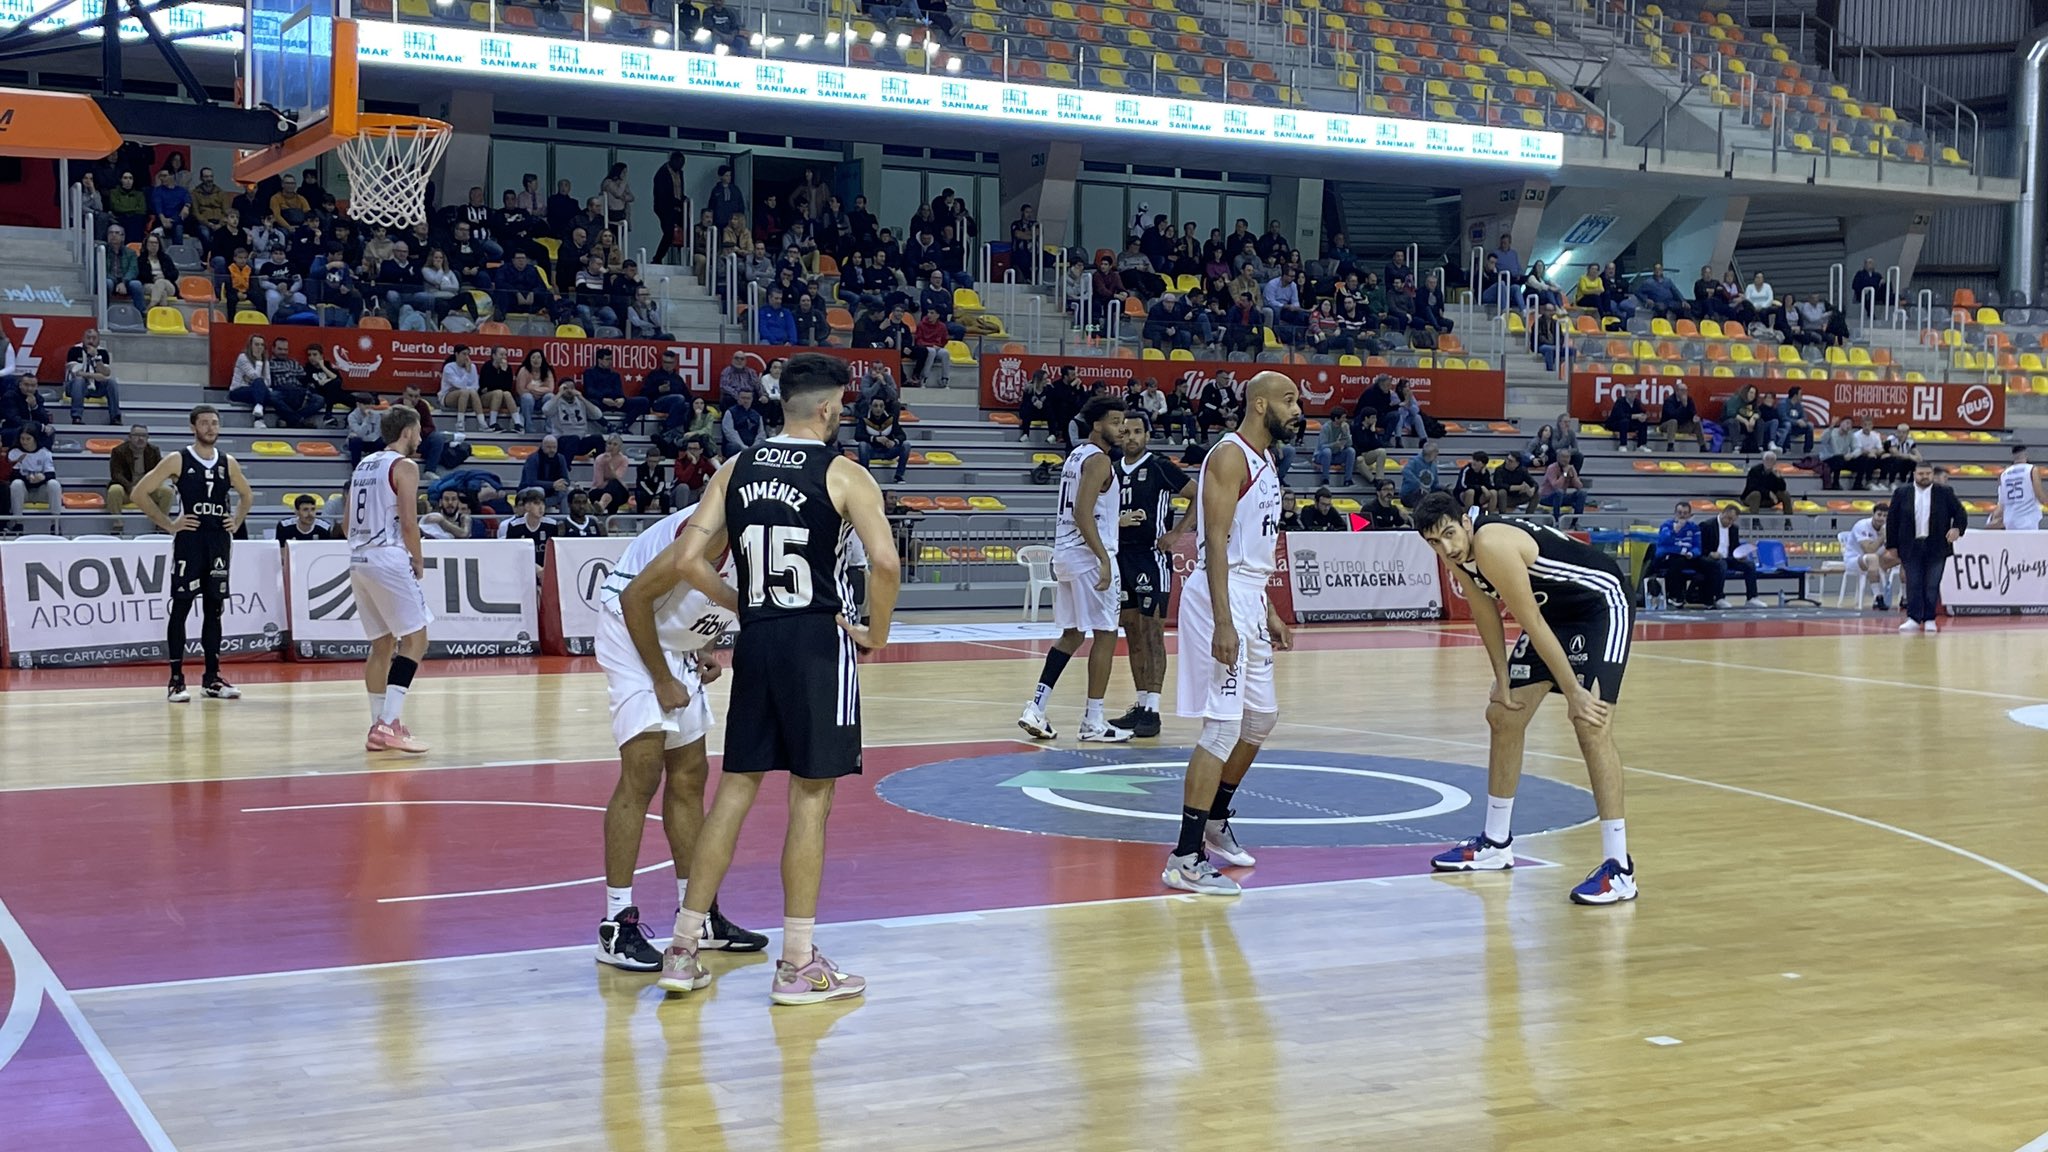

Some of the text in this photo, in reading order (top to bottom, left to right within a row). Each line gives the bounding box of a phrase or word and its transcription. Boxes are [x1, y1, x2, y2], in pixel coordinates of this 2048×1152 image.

[403, 51, 462, 63] SANIMAR
[480, 57, 537, 69] SANIMAR
[549, 64, 604, 76] SANIMAR
[621, 70, 675, 82] SANIMAR
[688, 77, 740, 89] SANIMAR
[757, 83, 806, 95] SANIMAR
[817, 89, 866, 100] SANIMAR
[881, 95, 930, 106] SANIMAR
[941, 100, 988, 111] SANIMAR
[1002, 106, 1048, 117] SANIMAR
[1057, 111, 1102, 121] SANIMAR
[1115, 116, 1158, 126] SANIMAR
[1169, 121, 1211, 131] SANIMAR
[1223, 126, 1265, 136] SANIMAR
[1273, 131, 1314, 140] SANIMAR
[1326, 135, 1367, 144] SANIMAR
[1376, 140, 1414, 149] SANIMAR
[1426, 144, 1464, 152] SANIMAR
[1472, 148, 1508, 156] SANIMAR
[392, 341, 434, 354] Puerto
[438, 344, 454, 355] de
[574, 344, 657, 369] HANEROS
[1041, 362, 1133, 378] Ayutamiento
[1341, 374, 1371, 385] Puerto
[1595, 376, 1682, 404] Fotin
[1834, 384, 1908, 405] LOS HABANEROS
[1853, 408, 1885, 418] HOTEL
[755, 447, 807, 465] ODILO
[206, 481, 214, 498] 7
[738, 478, 807, 512] JIMÉNEZ
[1120, 486, 1133, 505] 11
[2006, 481, 2024, 500] 25
[356, 488, 367, 525] 8
[178, 560, 187, 577] 7
[739, 524, 813, 608] 15
[1324, 558, 1405, 574] FÚTBOL CLUB
[1954, 554, 1992, 590] FCC
[1998, 548, 2047, 596] Business
[25, 554, 167, 601] NOW
[1325, 573, 1432, 587] CARTAGENA SAD
[31, 592, 267, 629] ARQUITETRA
[1320, 612, 1360, 621] CARTAGENA
[1385, 609, 1419, 620] VAMOS!
[184, 638, 243, 654] VAOS!
[319, 645, 338, 655] F.C.
[446, 644, 499, 656] VAMOS!
[1514, 633, 1529, 658] 3
[40, 646, 163, 665] F.C. CARTAGENA C.B.
